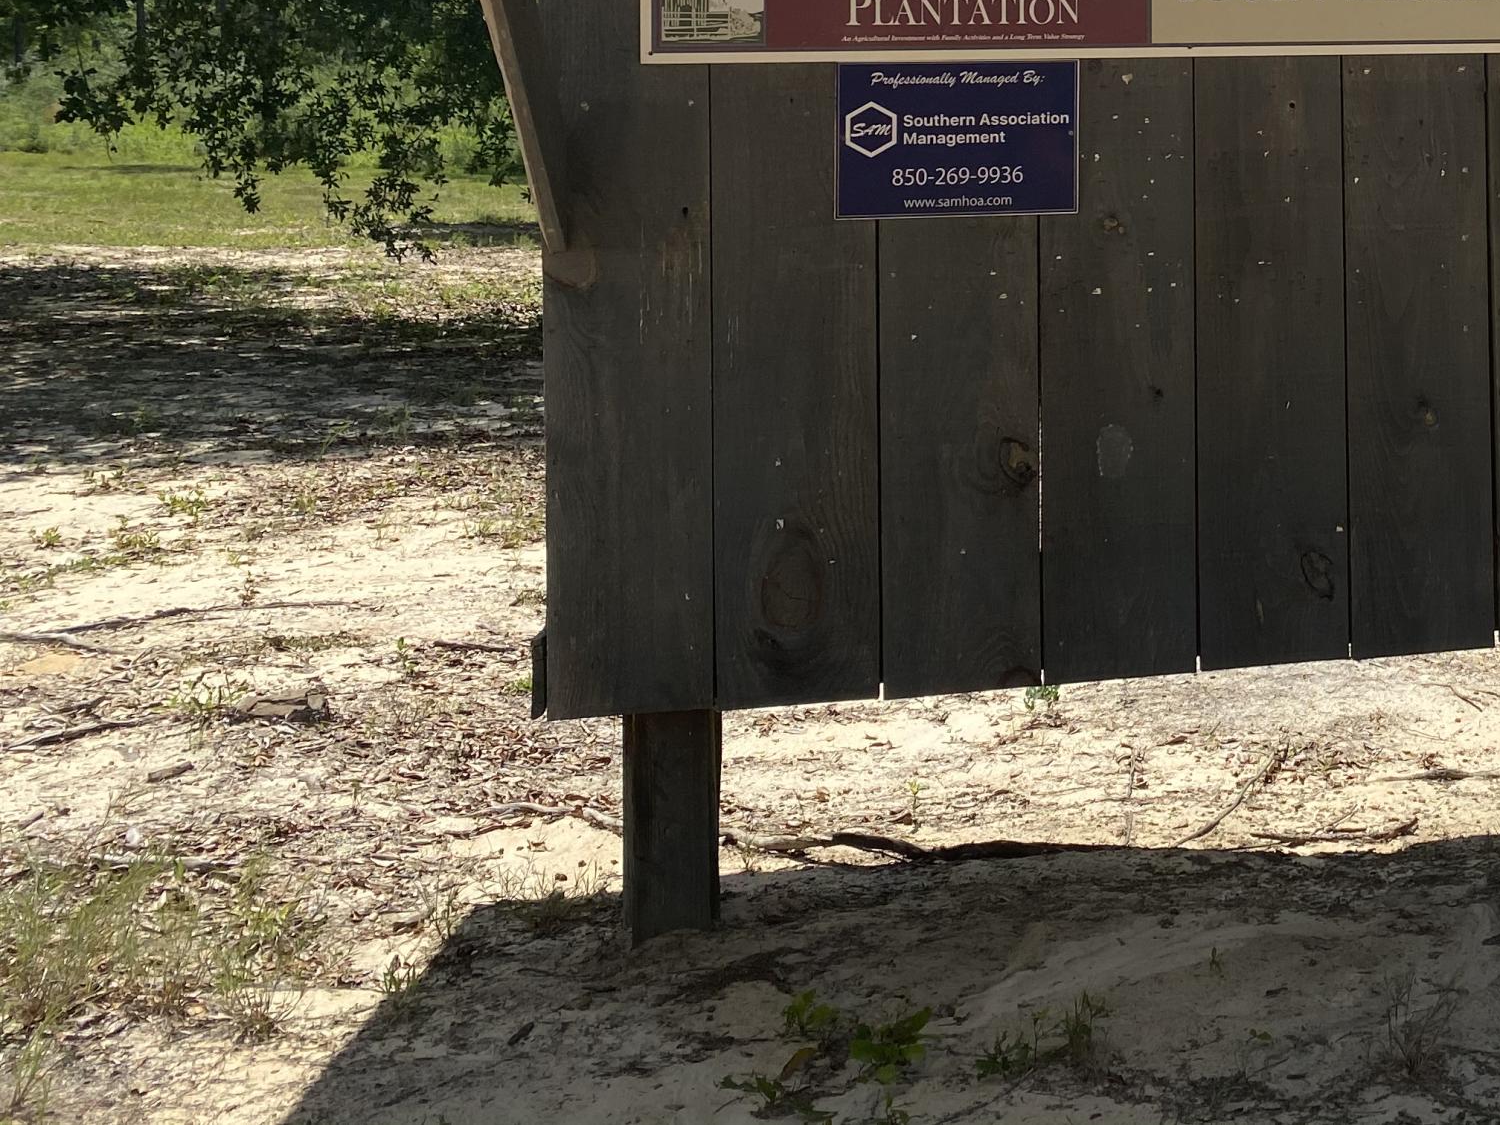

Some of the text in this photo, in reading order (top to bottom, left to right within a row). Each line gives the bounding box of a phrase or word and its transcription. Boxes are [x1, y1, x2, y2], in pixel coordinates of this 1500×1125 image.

[992, 33, 1005, 41] and
[870, 69, 1046, 89] Professionally Managed By:
[903, 111, 1070, 127] Southern Association
[850, 122, 892, 138] SAM
[903, 130, 1006, 147] Management
[891, 165, 1024, 187] 850-269-9936
[903, 194, 1013, 209] www.samhoa.com
